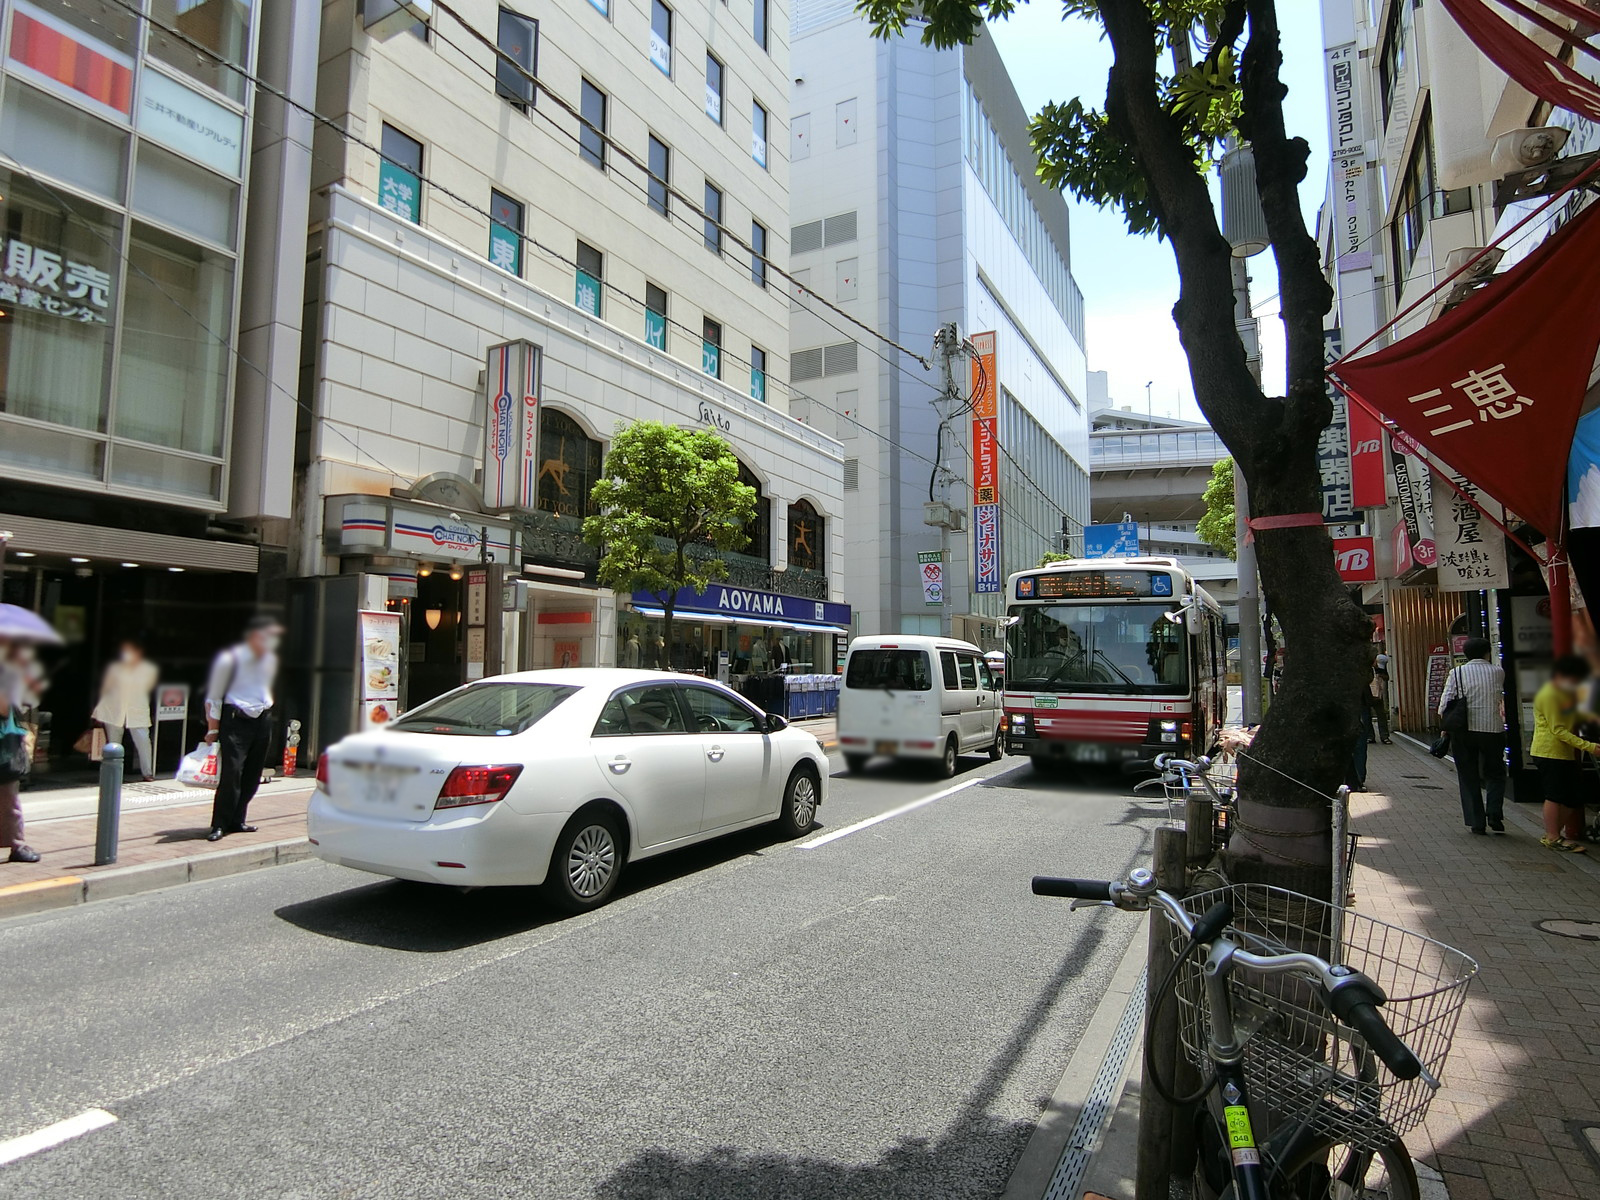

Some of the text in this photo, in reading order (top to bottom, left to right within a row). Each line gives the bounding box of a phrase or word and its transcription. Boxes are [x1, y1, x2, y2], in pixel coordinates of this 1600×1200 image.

[1331, 48, 1351, 59] 4F
[1341, 159, 1356, 168] 3F
[383, 177, 413, 200] 大学
[382, 193, 412, 220] 受験
[4, 238, 110, 308] 販売
[491, 236, 761, 400] 東 進 ハイ スク ール
[1408, 363, 1534, 436] 三恵
[498, 397, 507, 456] CHAT NOIR
[698, 401, 730, 432] Saito
[980, 420, 992, 486] サンドラッグ
[1353, 440, 1380, 456] JTB
[980, 488, 993, 502] 薬
[435, 530, 455, 542] CHAT
[979, 508, 995, 578] ジョナサン
[1420, 545, 1434, 559] 3F
[978, 583, 998, 592] B1F
[719, 589, 784, 615] AOYAMA
